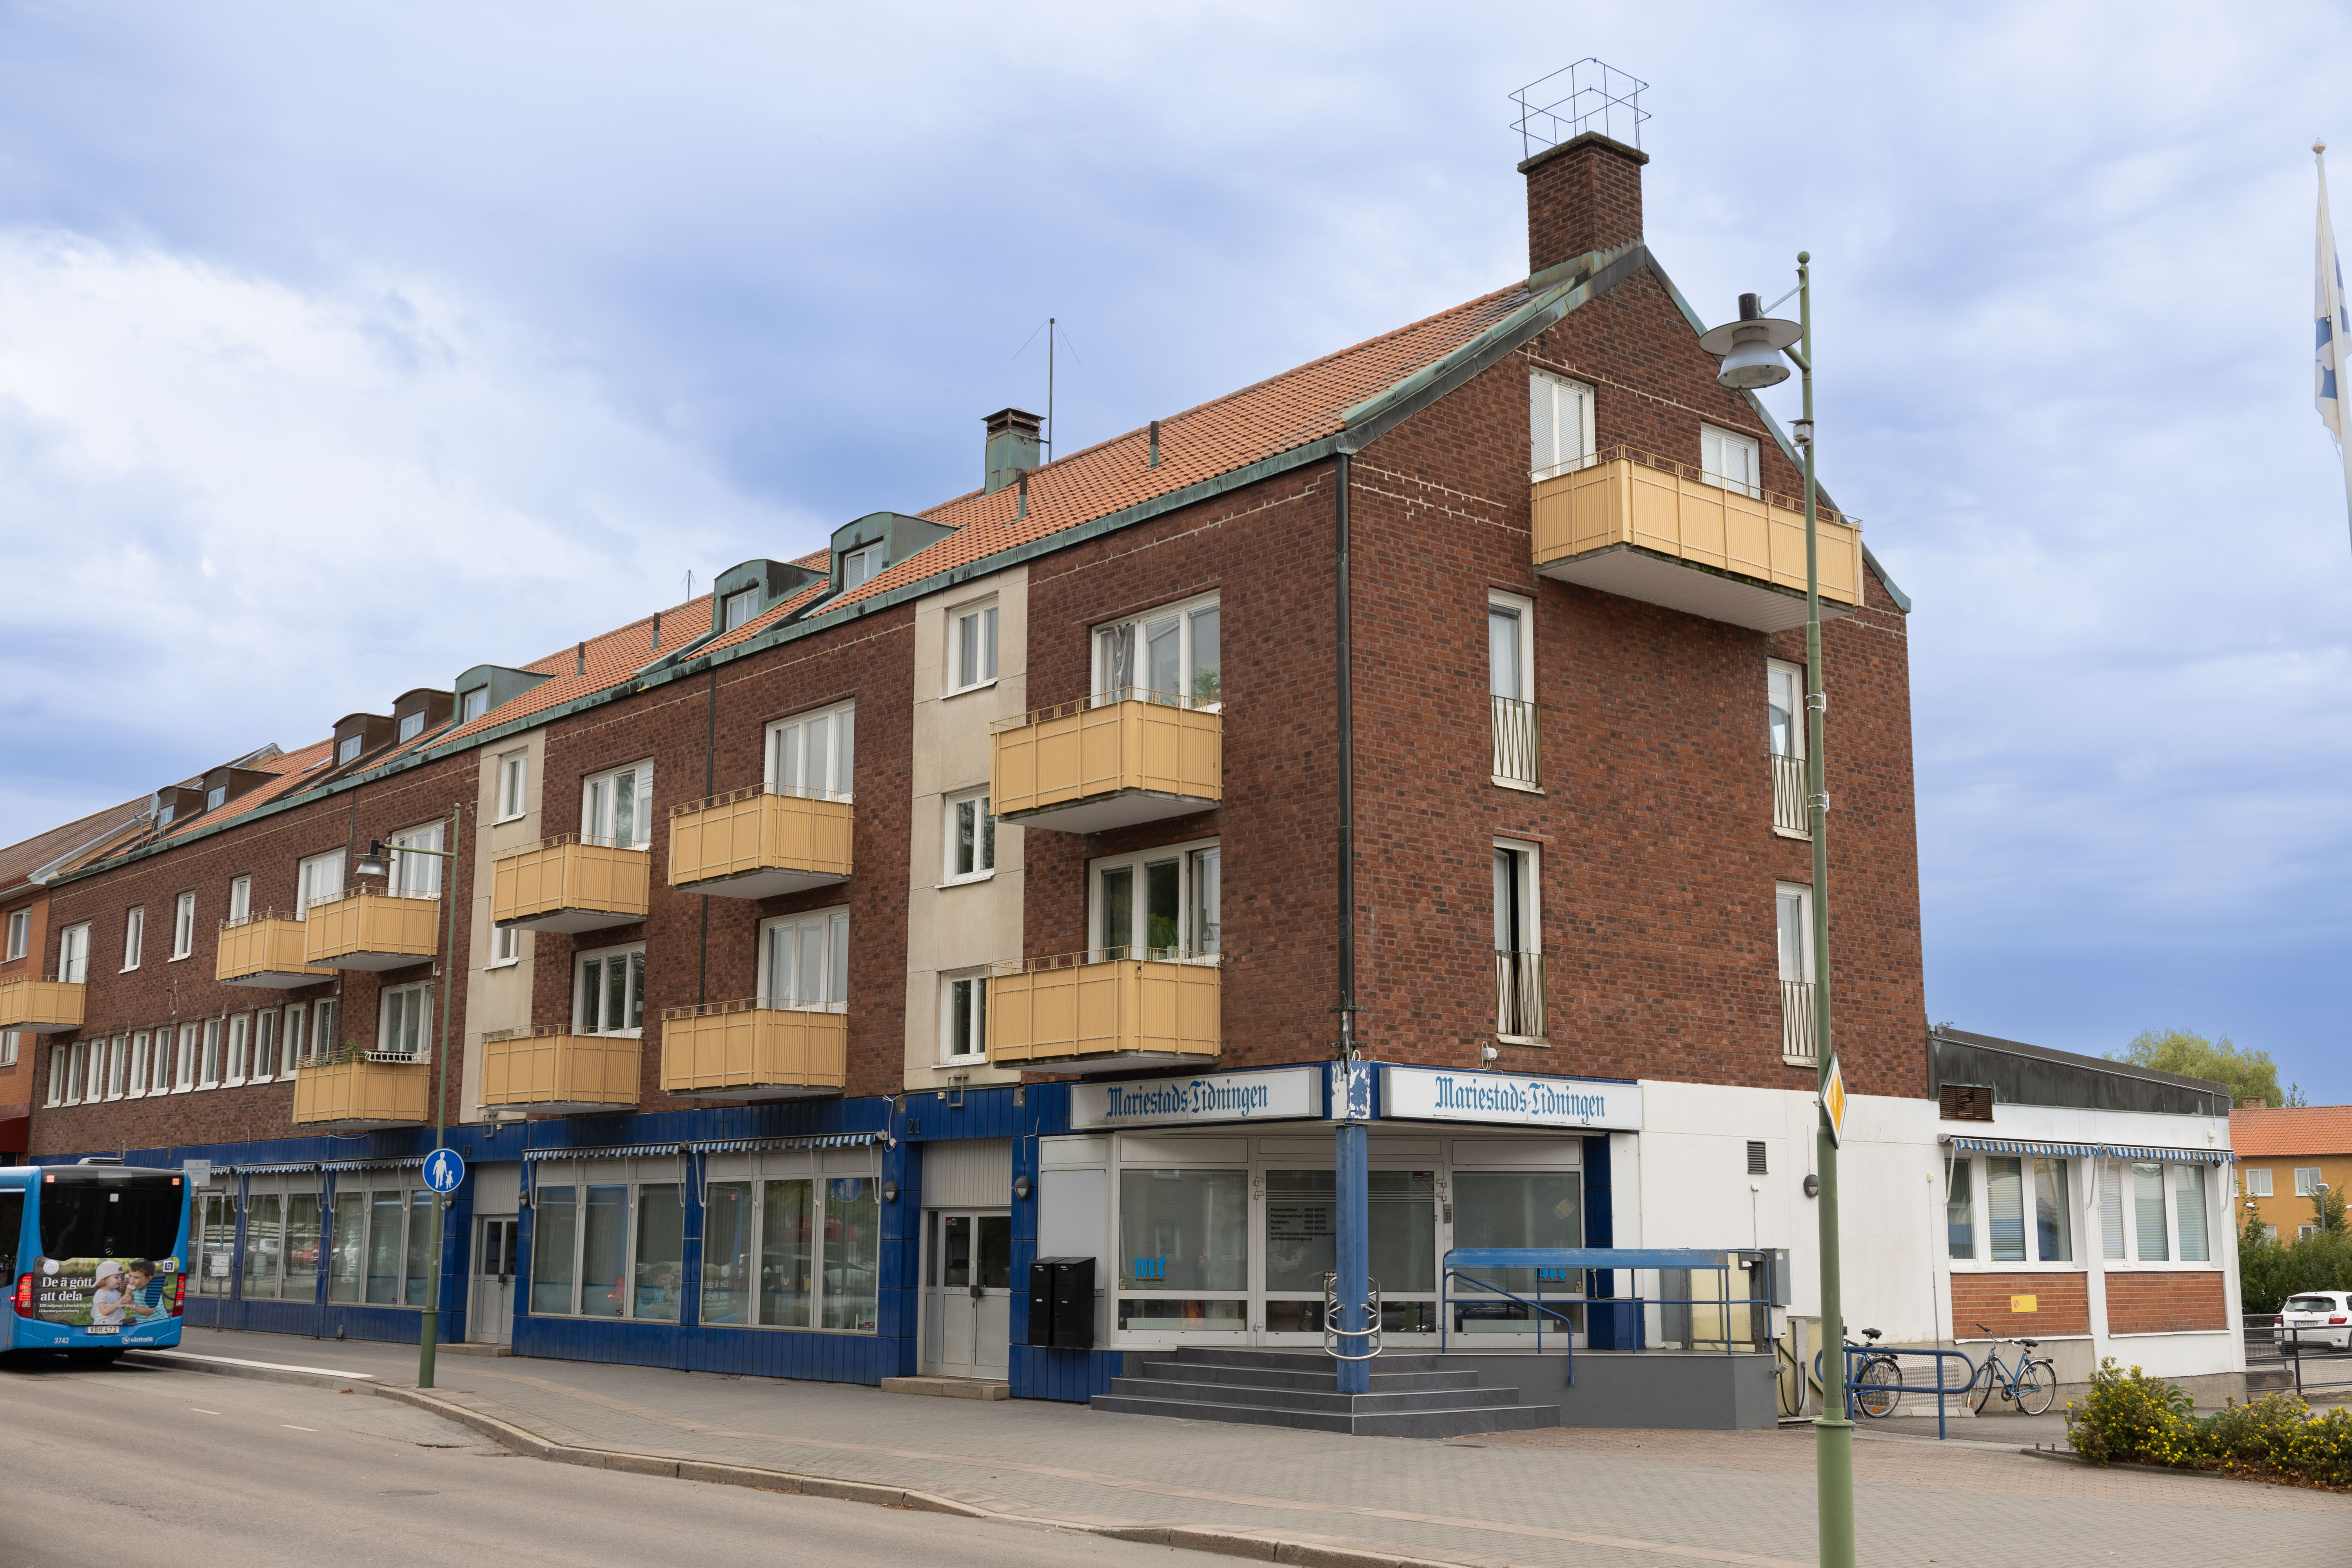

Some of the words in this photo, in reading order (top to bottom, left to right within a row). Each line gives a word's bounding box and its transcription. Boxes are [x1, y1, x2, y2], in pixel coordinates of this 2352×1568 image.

[907, 1118, 920, 1134] 21
[1133, 1251, 1167, 1278] mt
[42, 1277, 58, 1287] De
[60, 1277, 67, 1287] ä
[69, 1277, 93, 1290] gôtt
[40, 1292, 56, 1301] att
[59, 1291, 82, 1301] dela
